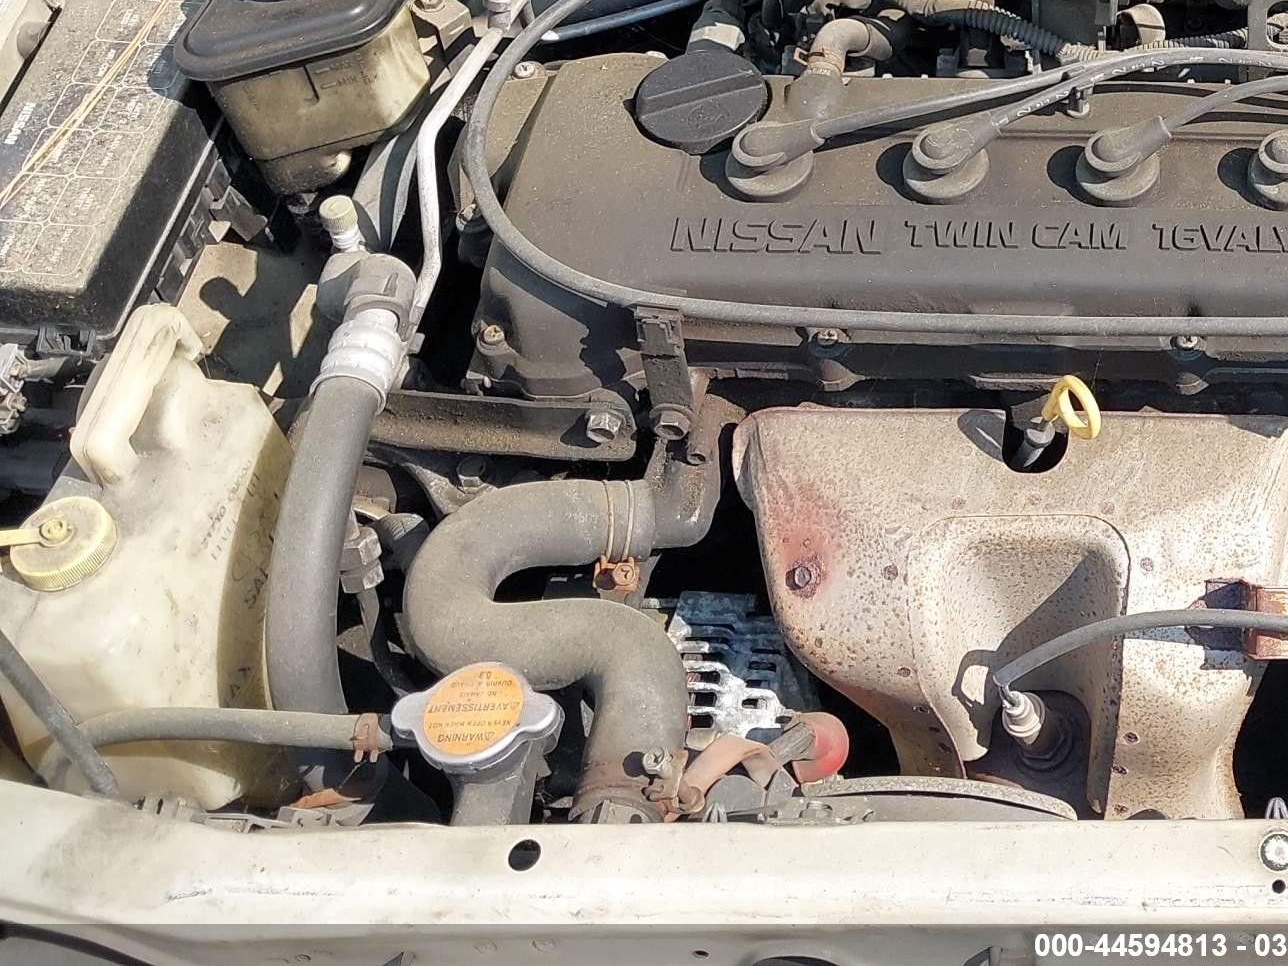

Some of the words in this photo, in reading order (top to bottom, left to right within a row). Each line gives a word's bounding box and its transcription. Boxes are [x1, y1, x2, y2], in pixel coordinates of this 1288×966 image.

[4, 103, 37, 145] NISSAN
[669, 216, 882, 255] NISSAN
[902, 220, 1018, 250] TWIN
[1032, 221, 1129, 251] CAM
[427, 702, 510, 714] AVERTISSEMENT
[436, 732, 484, 743] WARNING
